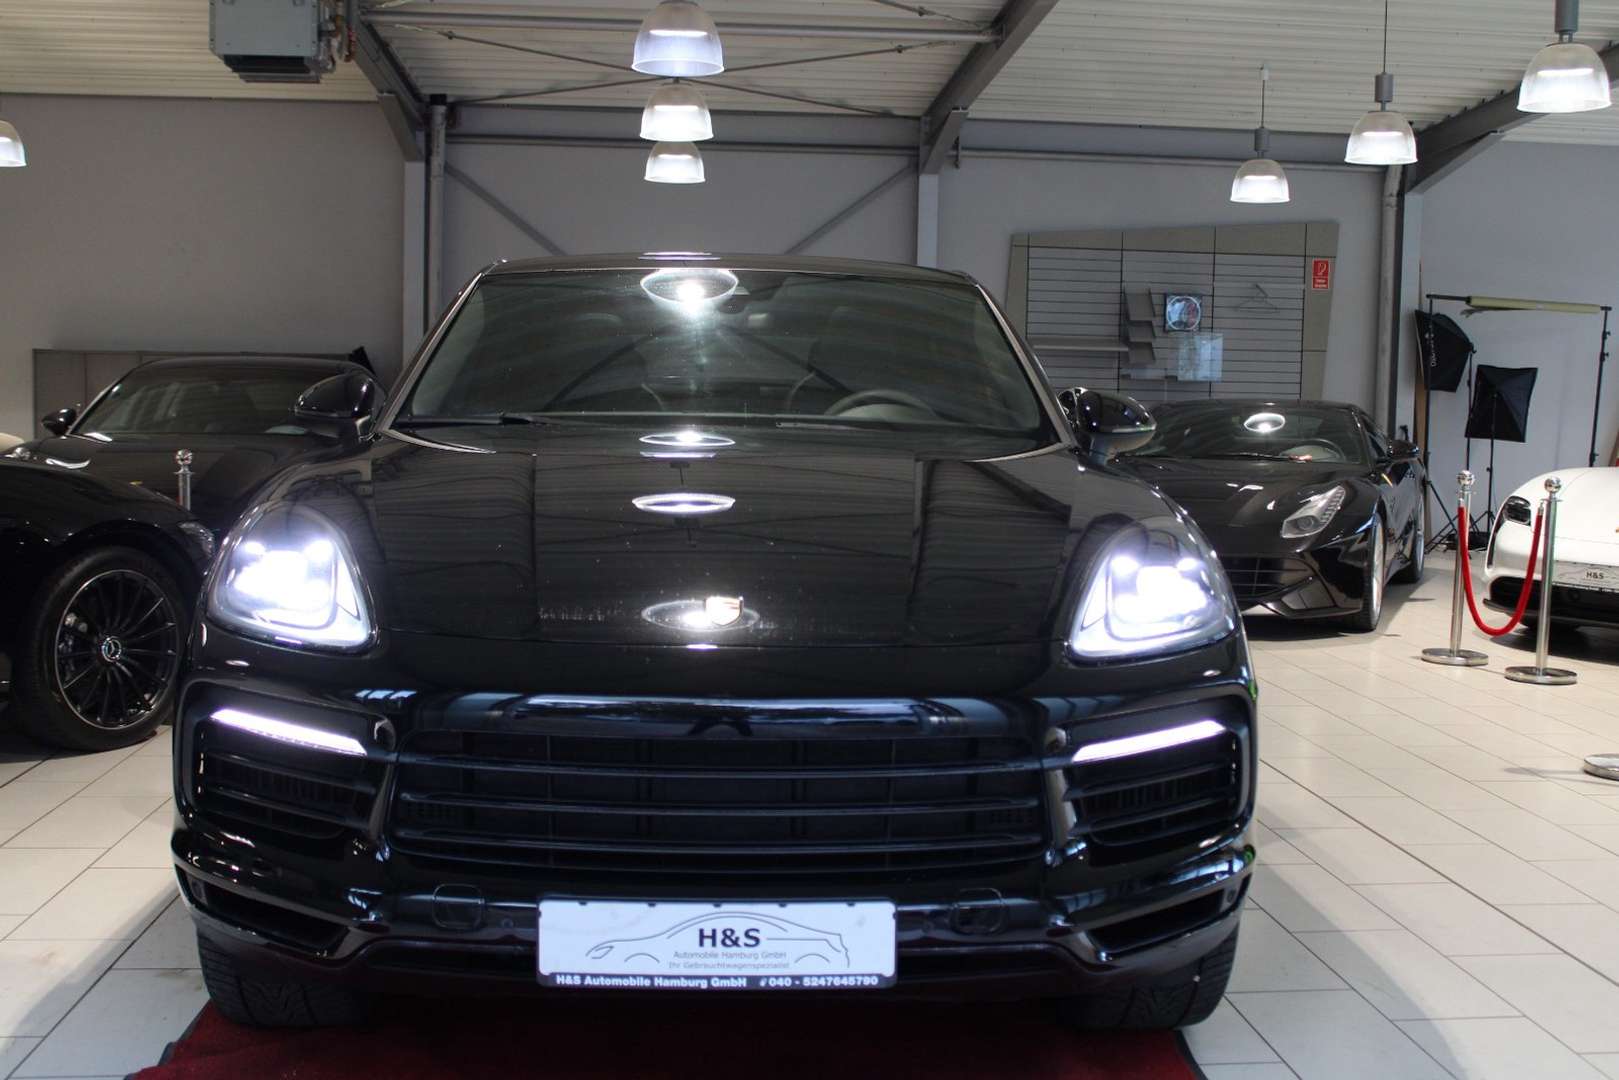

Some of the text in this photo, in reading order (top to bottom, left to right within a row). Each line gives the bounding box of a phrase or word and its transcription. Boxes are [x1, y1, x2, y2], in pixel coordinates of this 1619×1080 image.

[1586, 571, 1604, 580] H&S
[699, 928, 761, 947] H&S
[673, 951, 719, 959] Automobile
[721, 952, 759, 960] Hamburg
[669, 961, 681, 969] Ihr
[556, 974, 581, 985] H&S
[584, 975, 651, 987] Automobile
[654, 976, 708, 989] Hamburg
[710, 976, 747, 987] GmbH
[768, 977, 792, 987] 040
[802, 976, 879, 987] 5247645790
